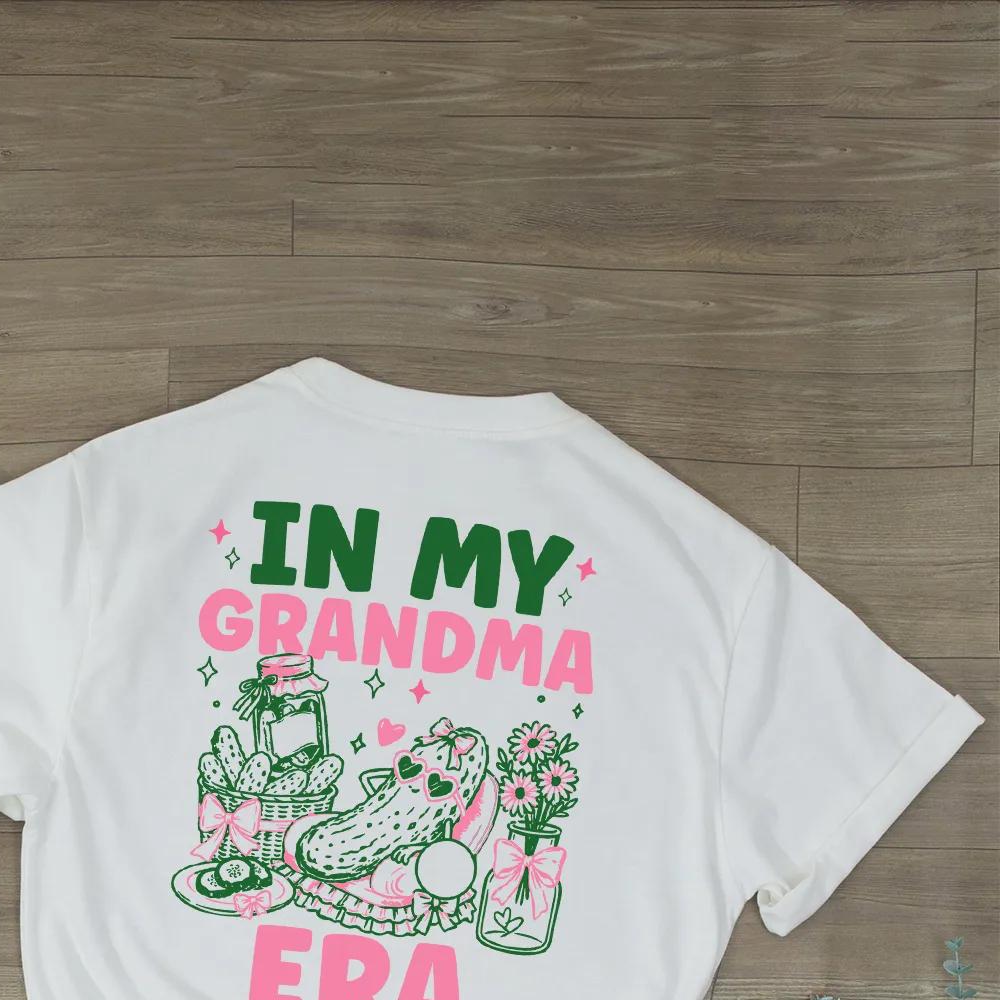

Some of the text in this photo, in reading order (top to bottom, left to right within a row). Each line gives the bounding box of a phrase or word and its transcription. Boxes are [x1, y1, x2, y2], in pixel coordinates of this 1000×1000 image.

[250, 501, 573, 617] IN MY
[199, 588, 593, 695] GRANDMA
